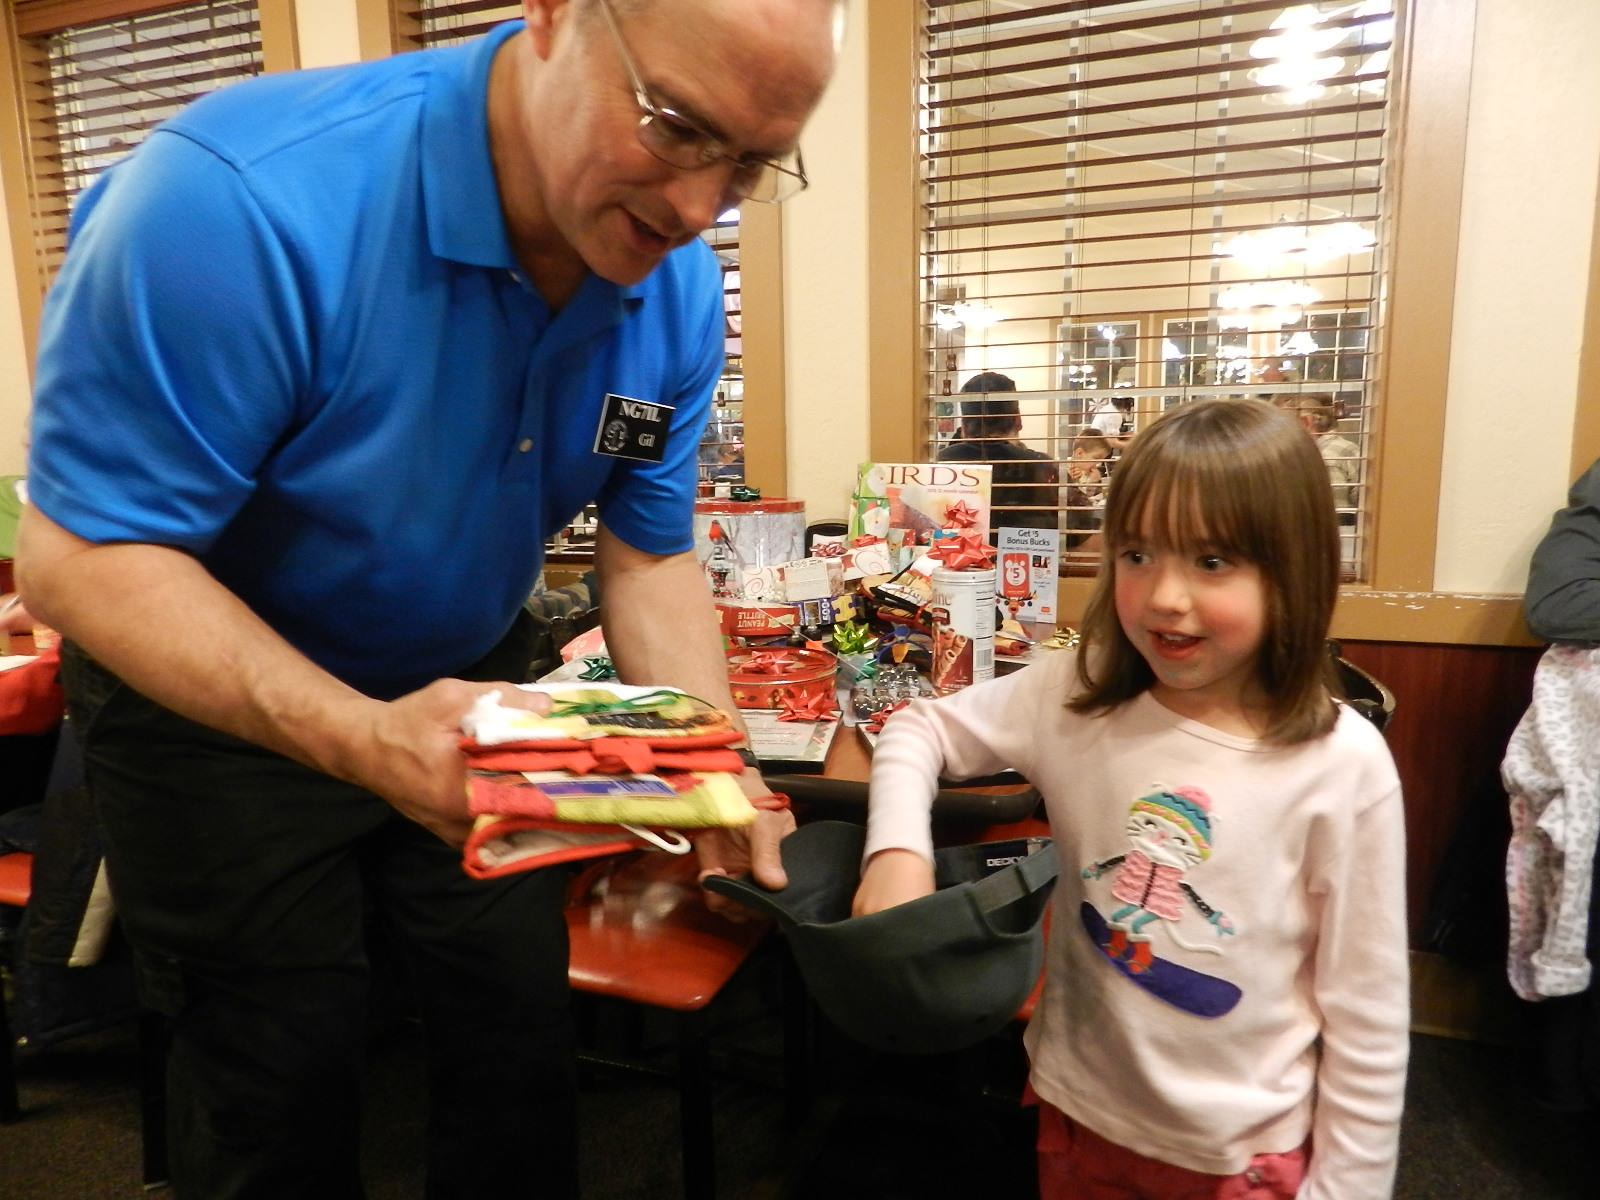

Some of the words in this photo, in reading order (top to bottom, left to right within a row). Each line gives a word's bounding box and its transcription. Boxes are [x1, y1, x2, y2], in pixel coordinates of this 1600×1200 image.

[888, 465, 981, 487] IRDS
[1017, 529, 1031, 538] Get
[1006, 536, 1029, 545] Bonus
[1029, 538, 1050, 546] Bucks
[737, 619, 765, 628] PEANUT
